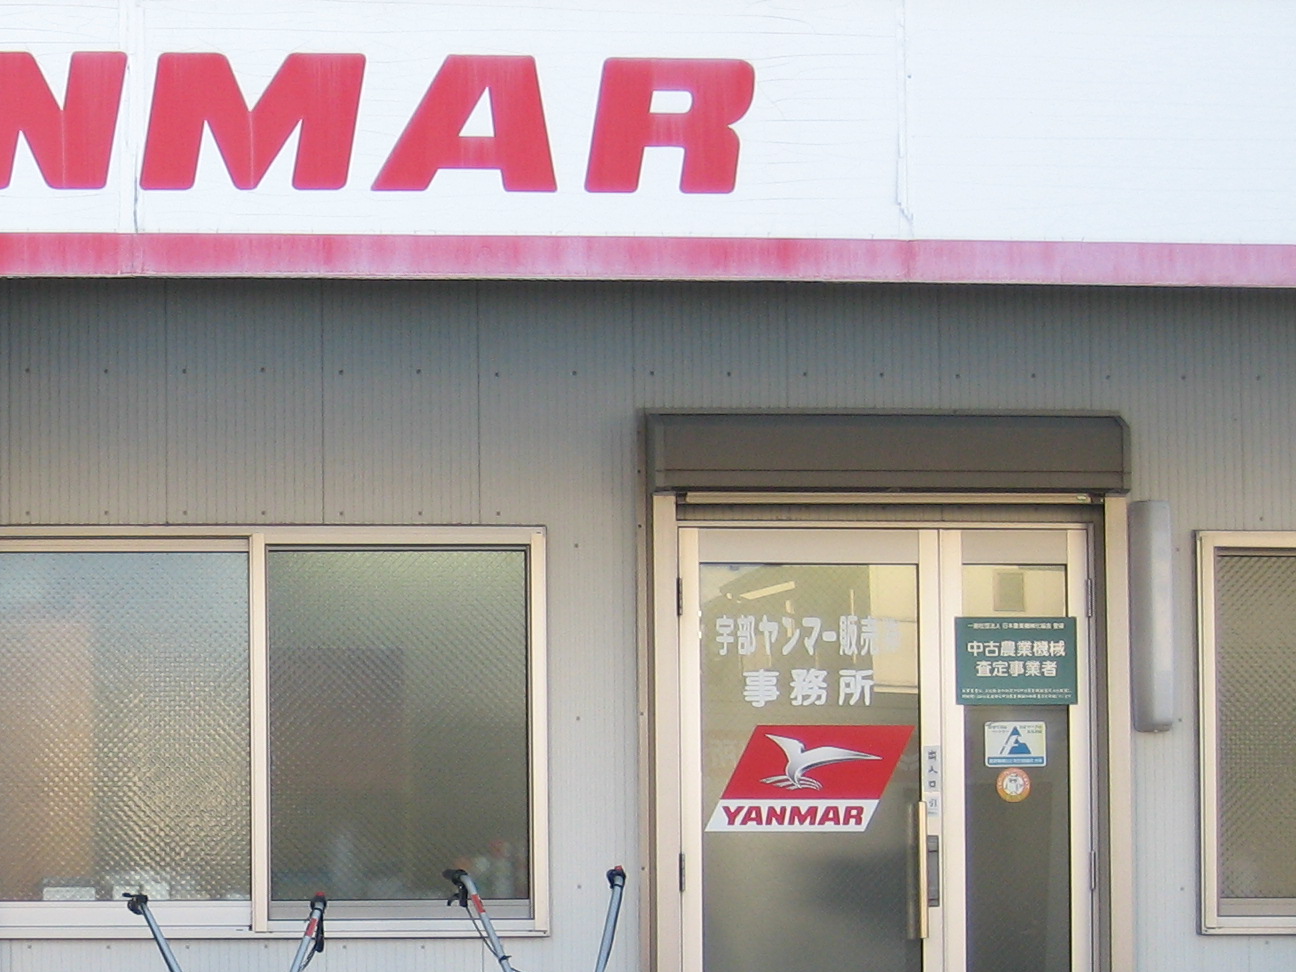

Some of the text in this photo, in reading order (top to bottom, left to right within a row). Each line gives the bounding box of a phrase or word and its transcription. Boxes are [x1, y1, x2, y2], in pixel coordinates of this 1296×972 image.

[716, 614, 901, 656] 宇部ヤンマー販売
[967, 640, 1066, 657] 中古農業機械
[975, 660, 1058, 677] 査定事業者
[742, 668, 875, 708] 事務所
[721, 805, 865, 826] YANMAR
